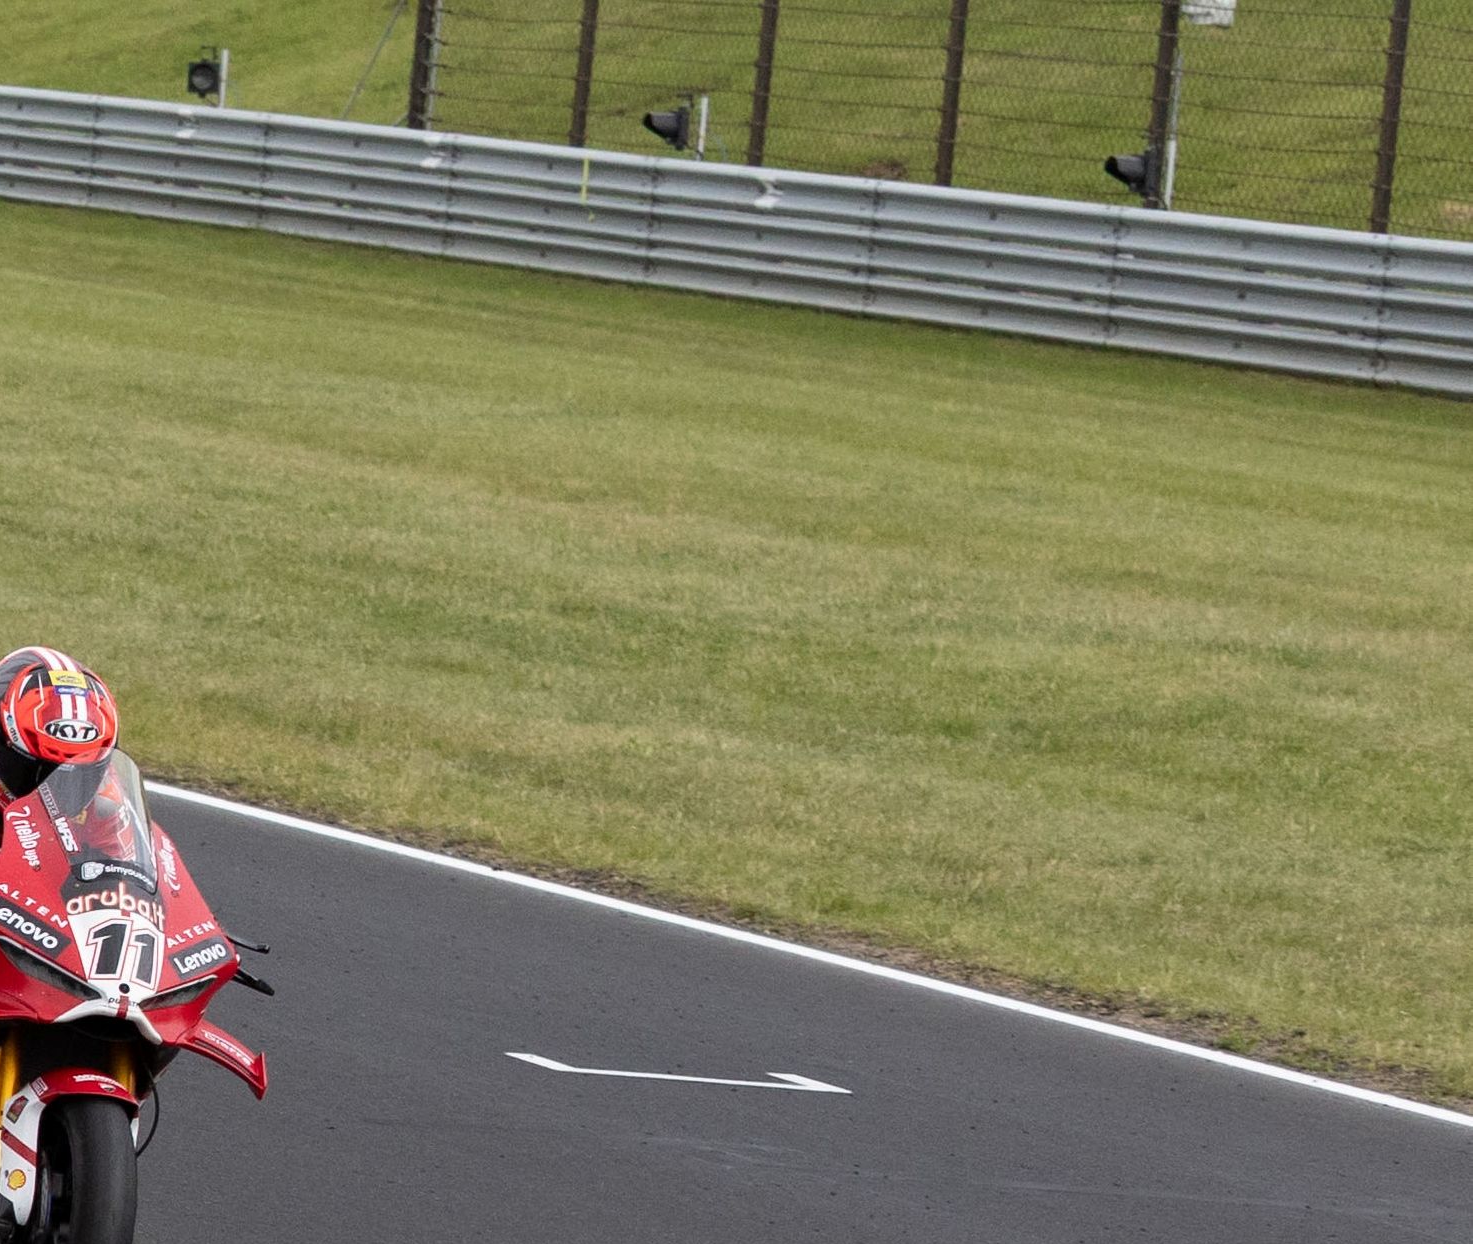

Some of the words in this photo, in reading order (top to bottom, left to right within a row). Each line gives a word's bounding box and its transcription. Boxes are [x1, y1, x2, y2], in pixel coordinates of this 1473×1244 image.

[47, 722, 98, 741] KYT
[12, 821, 41, 850] riello
[55, 816, 79, 852] WRS
[22, 848, 41, 867] ups
[166, 921, 216, 949] ALTEN
[89, 920, 160, 988] 11
[173, 943, 227, 974] Lenovo
